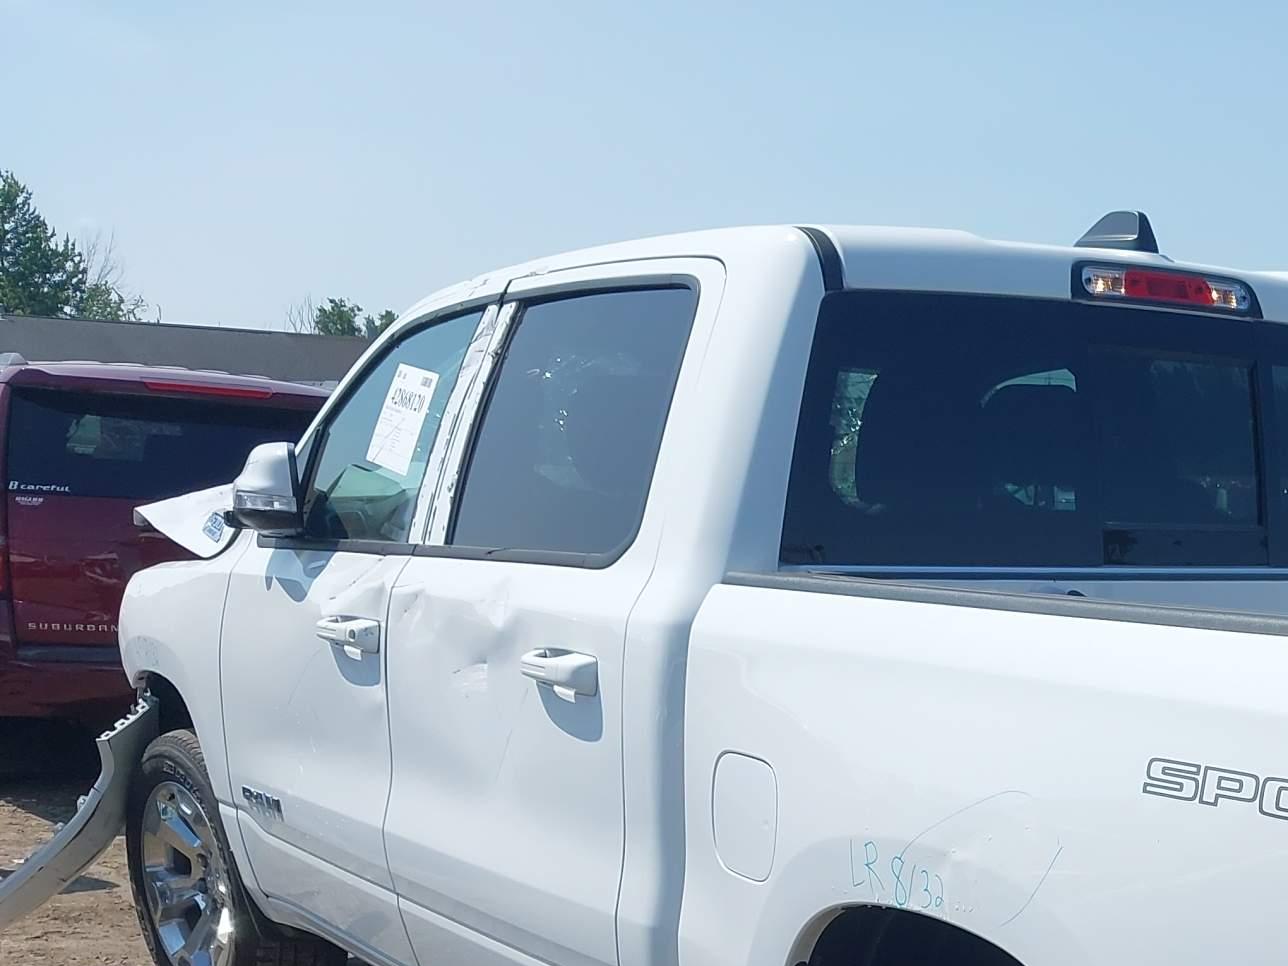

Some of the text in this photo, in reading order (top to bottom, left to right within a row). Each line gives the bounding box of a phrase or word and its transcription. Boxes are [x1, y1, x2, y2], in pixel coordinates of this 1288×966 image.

[391, 387, 426, 414] 42868120
[28, 622, 119, 633] SUBURBAN
[849, 838, 885, 895] LR
